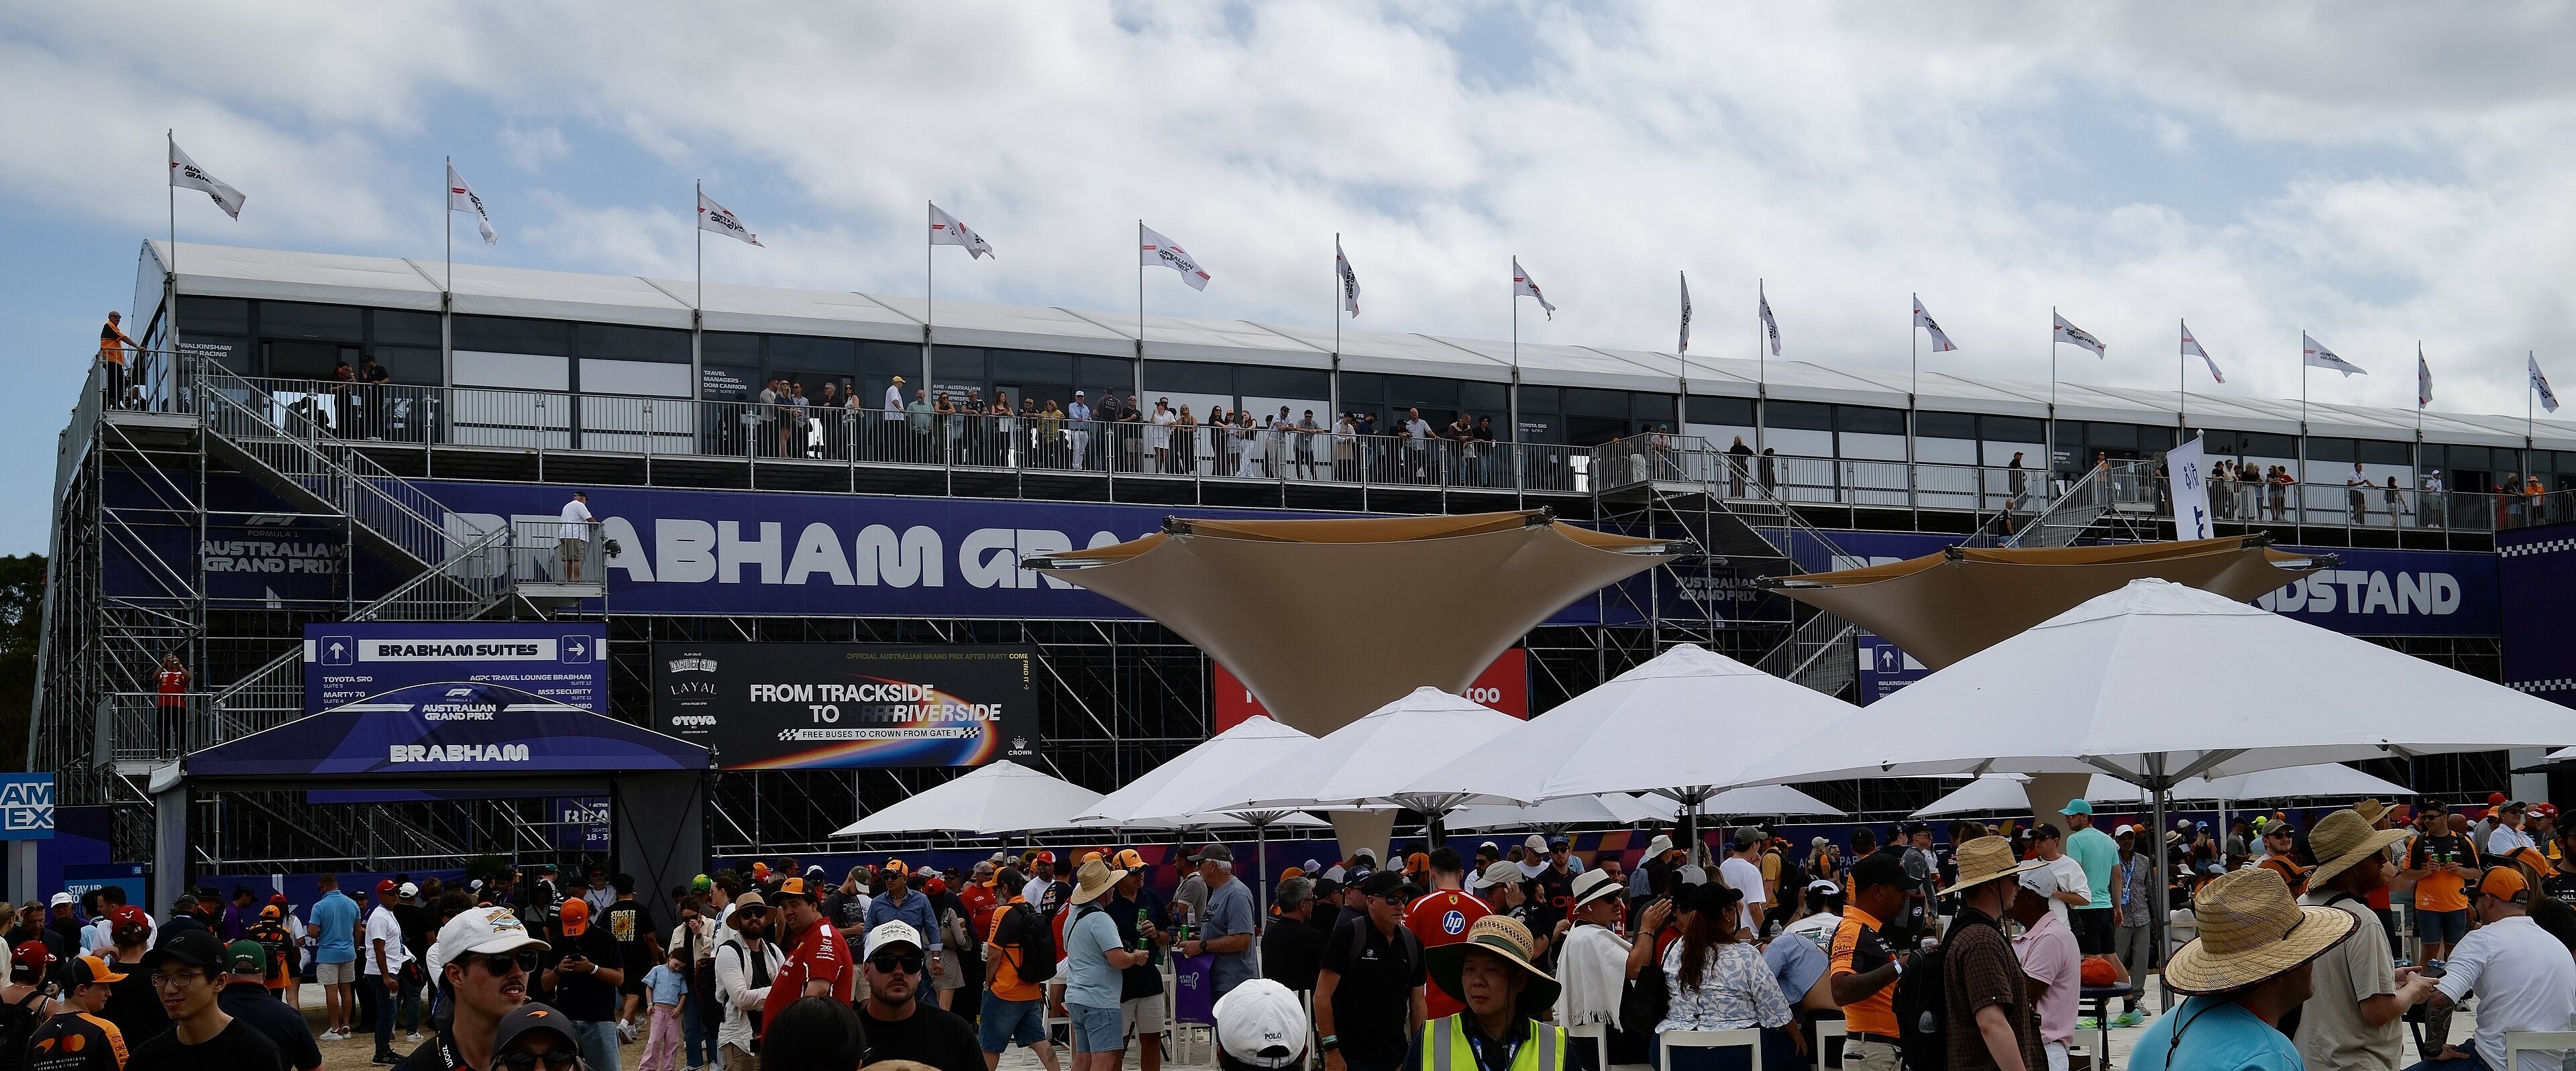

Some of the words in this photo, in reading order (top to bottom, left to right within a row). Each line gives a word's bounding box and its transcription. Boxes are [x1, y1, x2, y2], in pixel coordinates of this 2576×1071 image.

[180, 343, 232, 351] WALKINSHAW
[204, 557, 285, 572] GRAND
[378, 644, 476, 657] BRABHAM
[476, 644, 538, 656] SUITES
[670, 681, 717, 695] LAYAL
[750, 684, 813, 702] FROM
[818, 684, 934, 702] TRACKSIDE
[422, 704, 496, 712] AUSTRALIAN
[809, 705, 839, 723] TO
[390, 744, 529, 763] BRABHAM
[1, 783, 54, 805] AM
[5, 807, 54, 830] EX
[68, 885, 88, 894] STAY
[1445, 911, 1462, 933] hp
[442, 1045, 453, 1068] zoom
